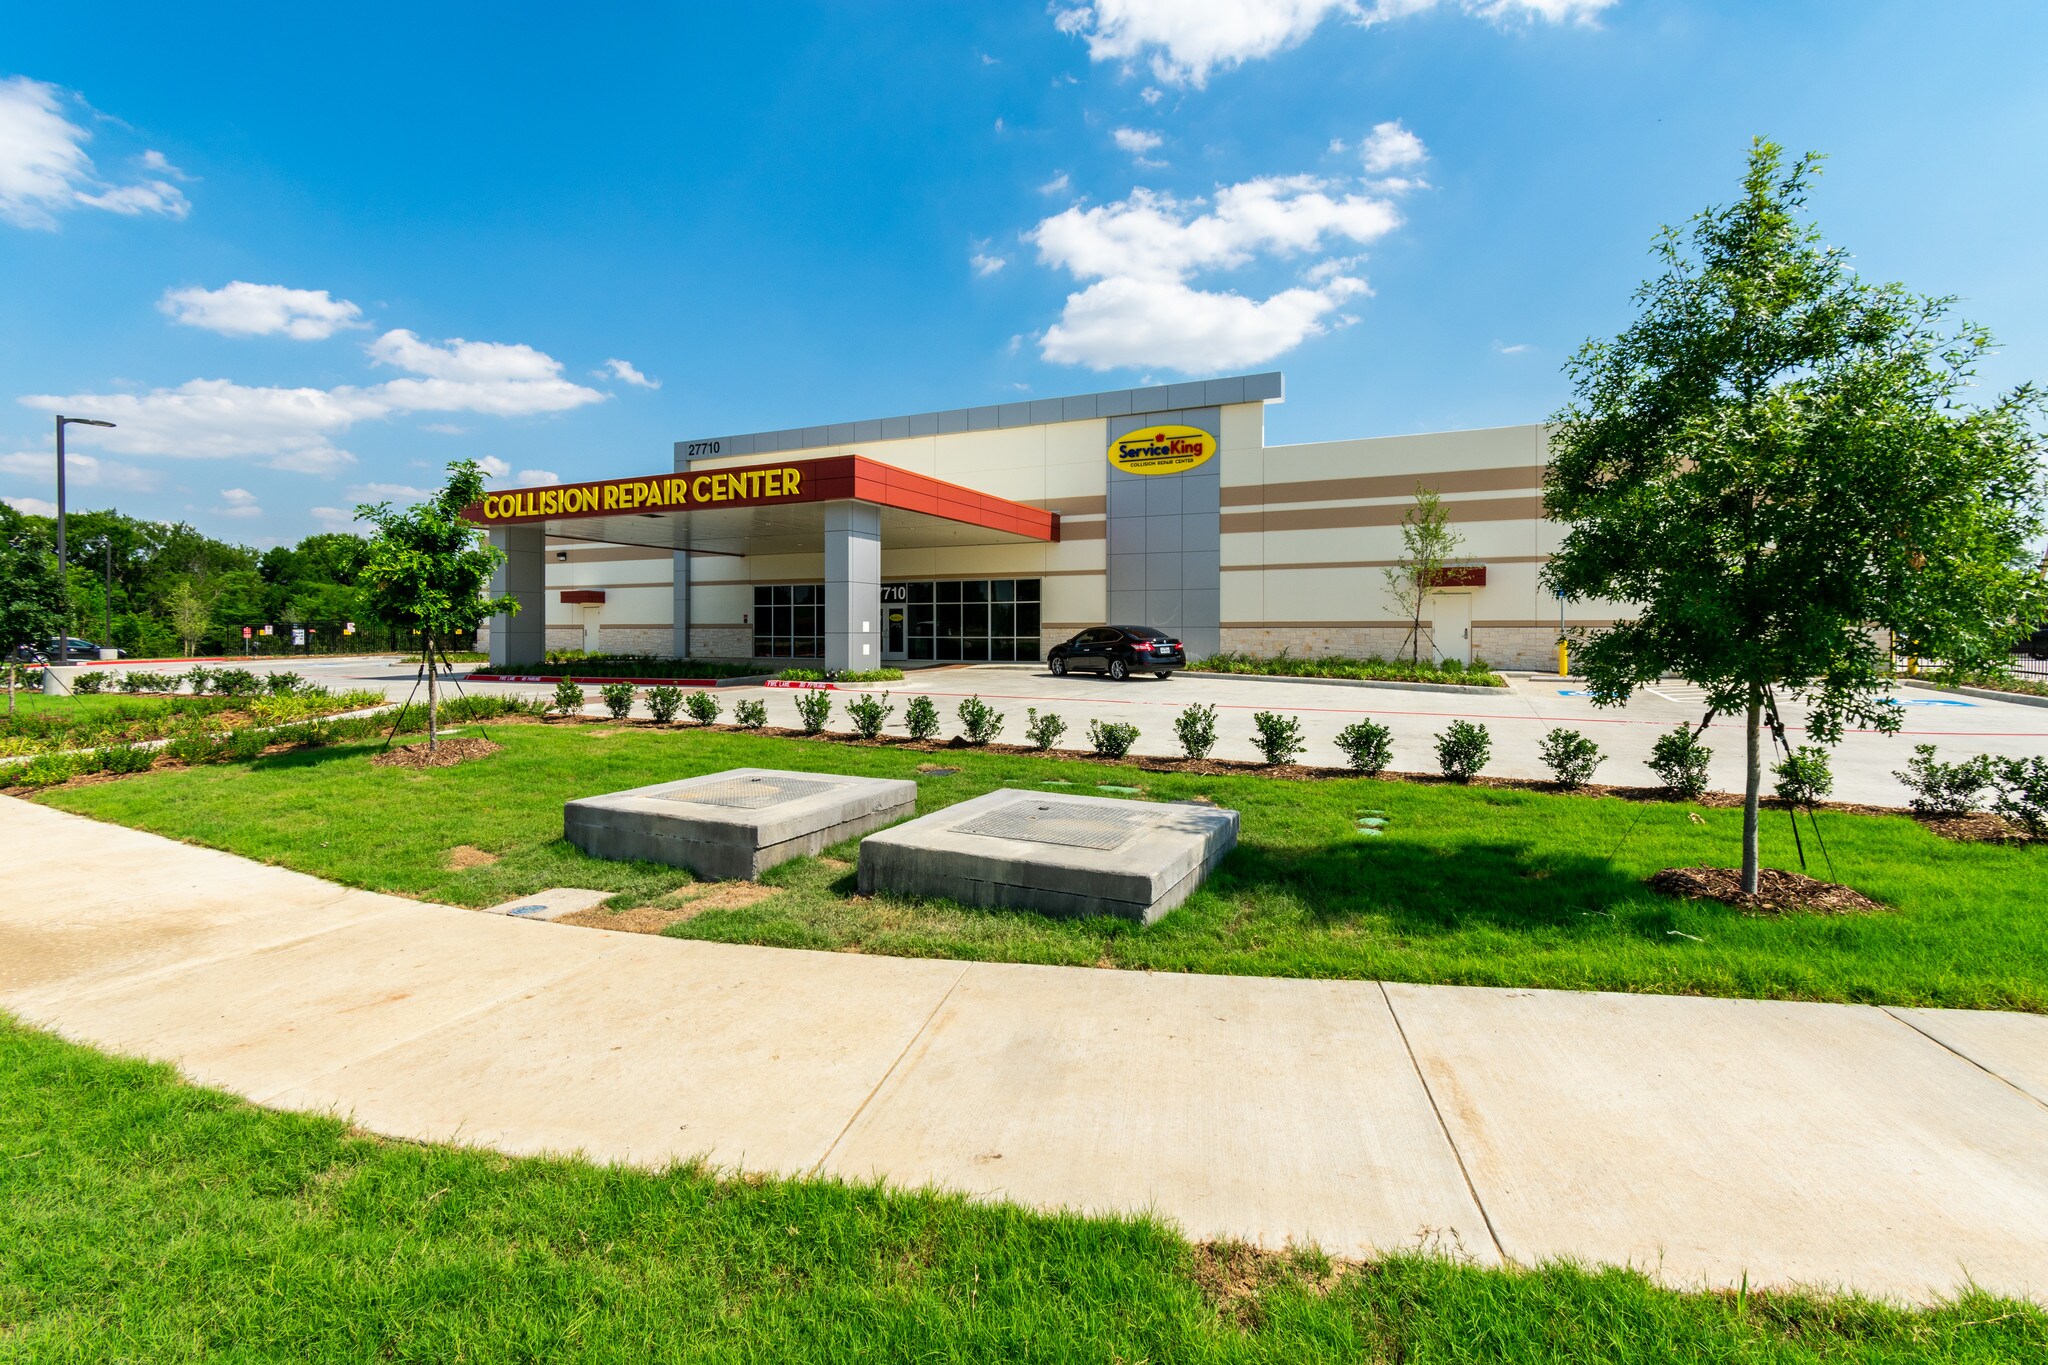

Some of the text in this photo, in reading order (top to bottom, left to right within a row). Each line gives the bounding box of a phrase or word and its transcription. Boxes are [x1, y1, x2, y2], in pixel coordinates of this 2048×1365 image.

[688, 442, 720, 456] 27710
[483, 467, 801, 519] COLLISION REPAIR CENTER
[880, 586, 906, 600] 710
